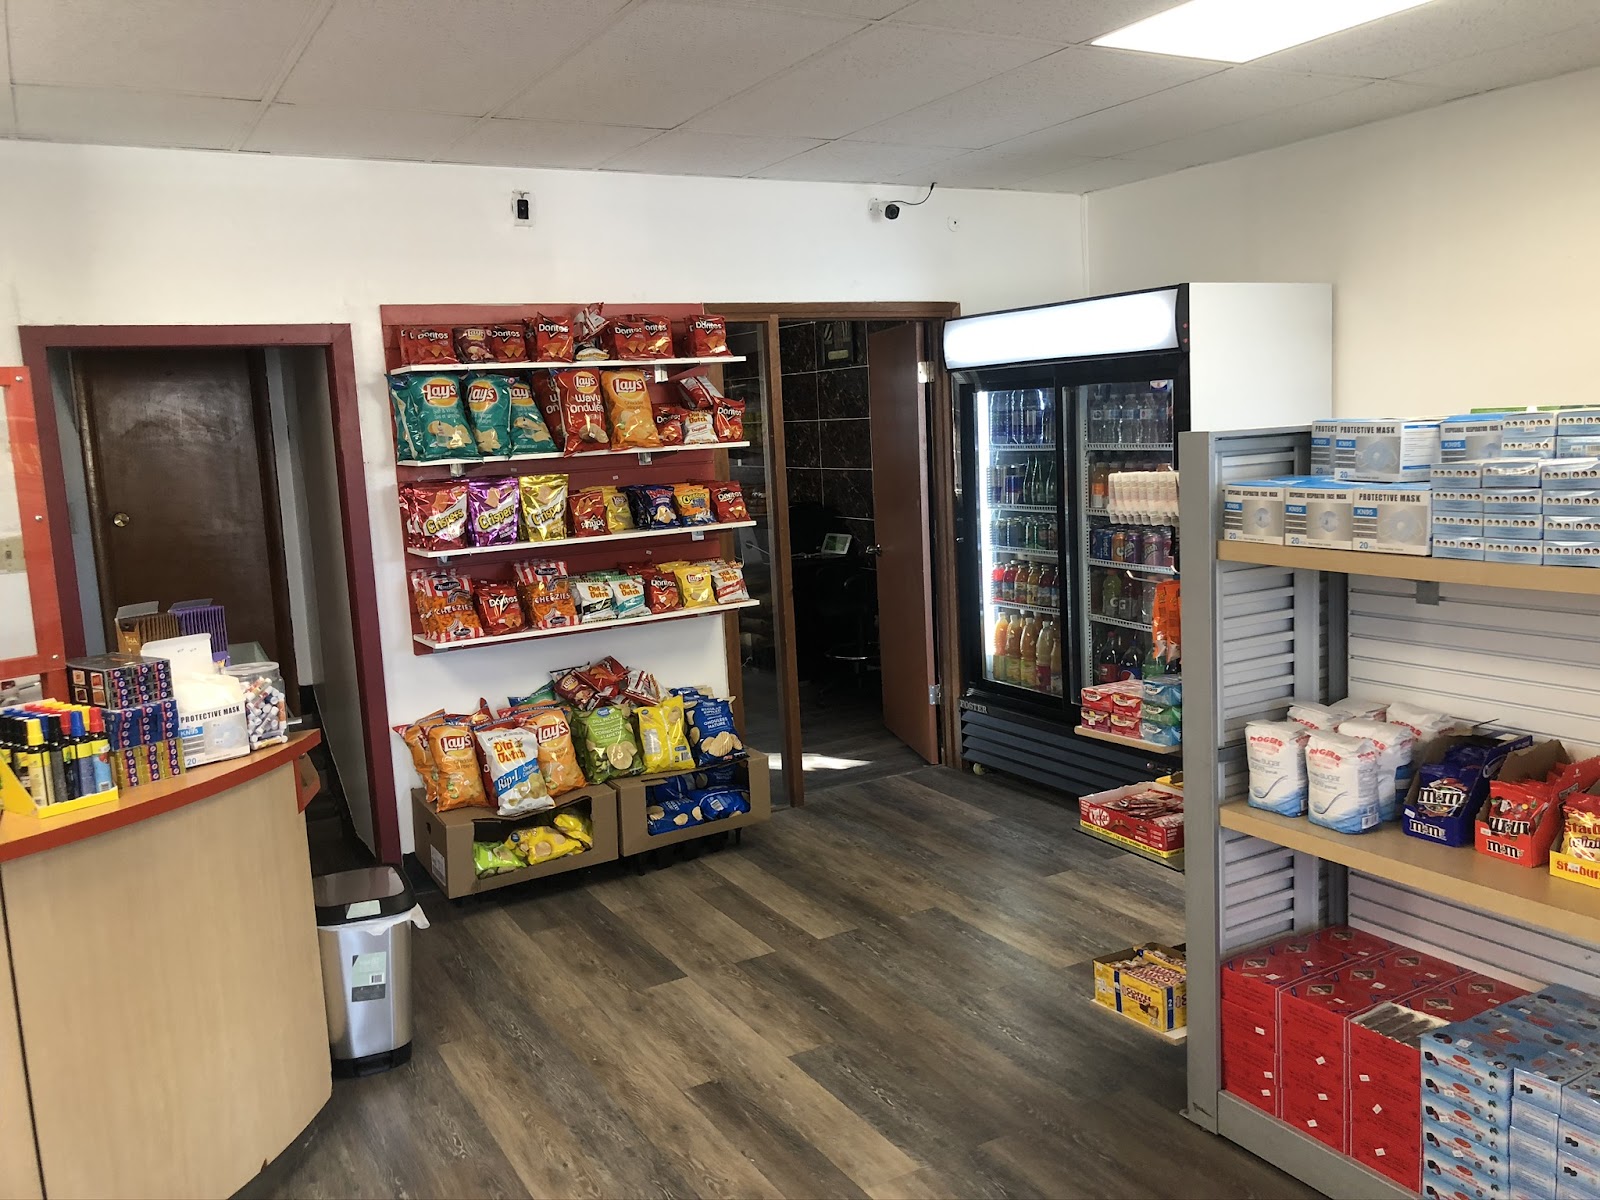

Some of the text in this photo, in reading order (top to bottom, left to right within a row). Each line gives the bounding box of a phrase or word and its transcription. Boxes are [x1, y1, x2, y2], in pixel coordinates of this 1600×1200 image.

[538, 323, 570, 333] Doritos
[645, 324, 667, 332] oritos
[576, 376, 596, 388] Lay's
[615, 379, 643, 393] Lay's
[424, 383, 457, 400] Lay's
[468, 387, 495, 402] Lay's
[575, 394, 601, 404] Wavy
[718, 406, 742, 416] Doritos
[1315, 425, 1337, 433] PROTECT
[1340, 426, 1396, 434] PROTECTIVE MASK
[1340, 471, 1348, 479] 20
[717, 491, 743, 502] Doritos
[1358, 493, 1421, 503] PROTECTIVE MASK
[426, 509, 465, 535] Crispers
[478, 504, 514, 530] Crispers
[1229, 532, 1237, 540] 20
[1291, 537, 1300, 545] 20
[1359, 542, 1369, 550] 20
[651, 580, 676, 588] Doritos
[534, 592, 571, 604] CHEEZIES
[590, 591, 610, 599] Dutch
[489, 595, 518, 607] Doritos
[435, 605, 473, 615] CHEEZIES
[959, 699, 988, 714] FOSTER
[180, 705, 240, 724] PROTECTIVE MASK
[538, 721, 568, 744] Lay's
[443, 734, 472, 752] Lay's
[493, 740, 514, 753] Old
[187, 757, 197, 766] 20
[1569, 835, 1600, 849] mini
[1556, 860, 1600, 880] Stbur
